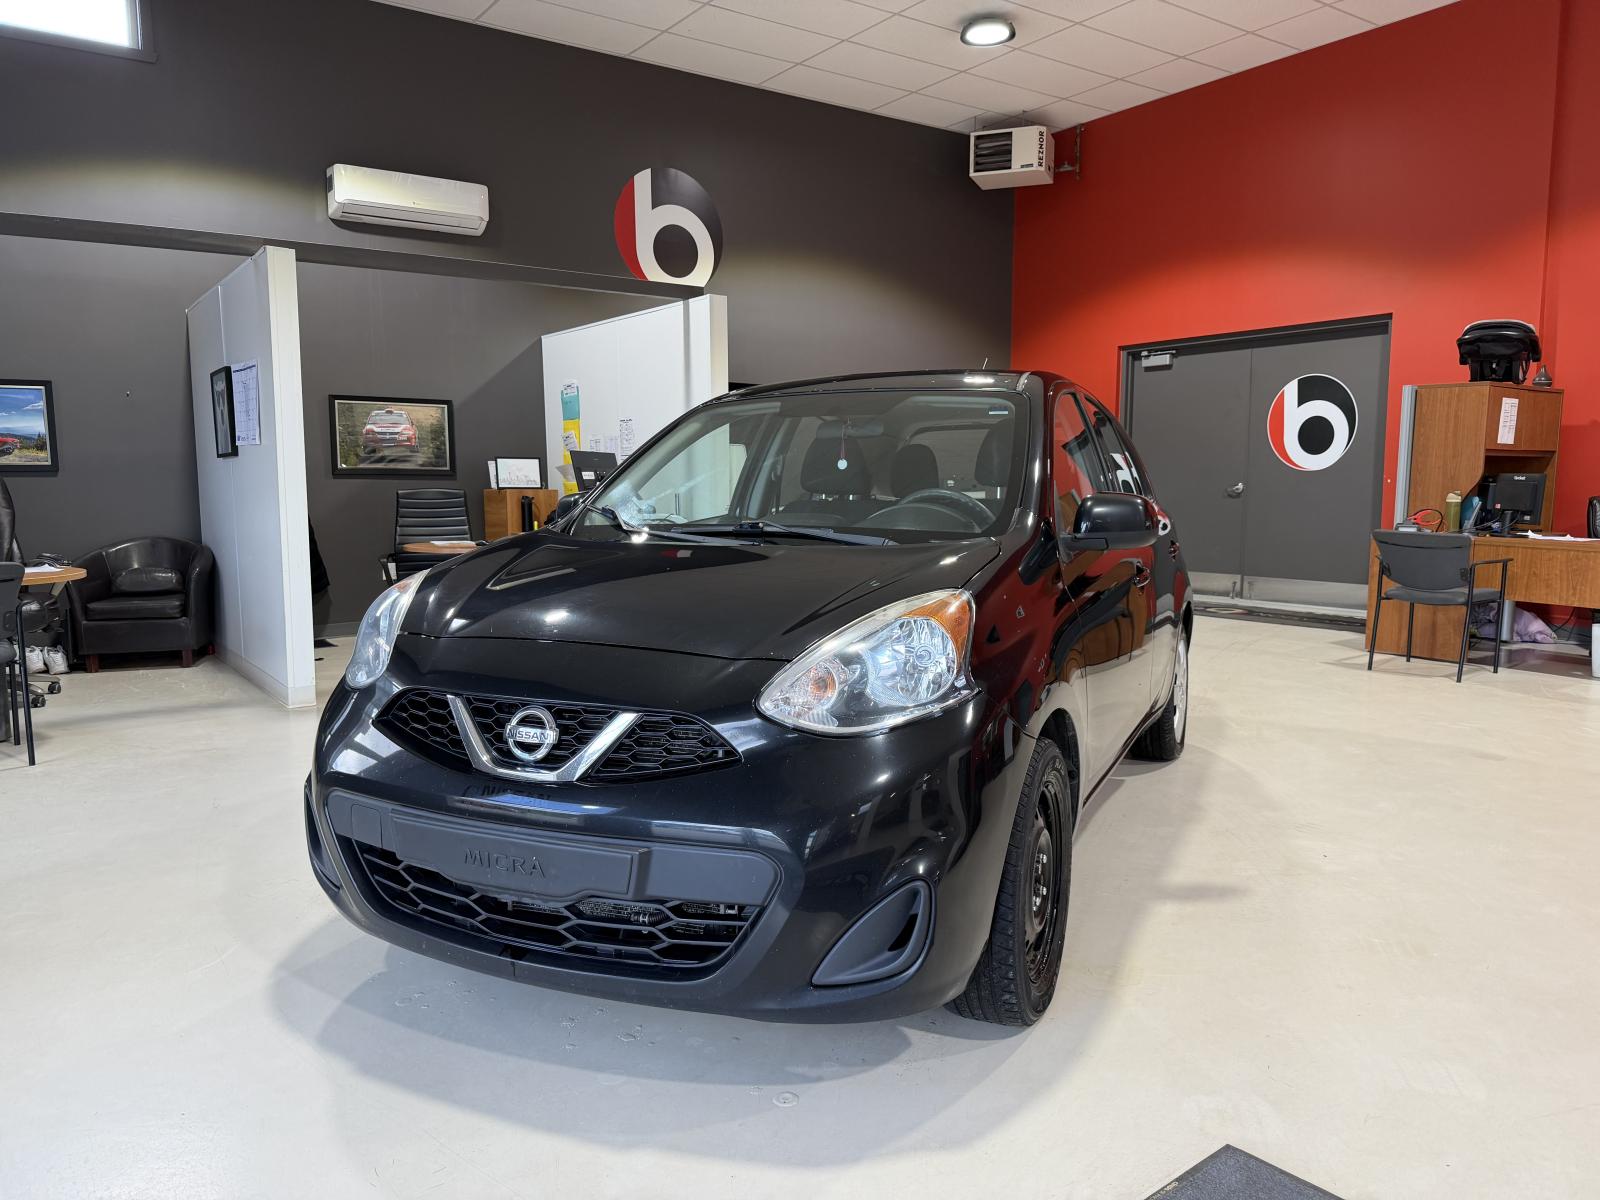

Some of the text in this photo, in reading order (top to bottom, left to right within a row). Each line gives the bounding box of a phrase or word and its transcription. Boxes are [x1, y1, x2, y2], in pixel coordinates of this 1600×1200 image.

[633, 167, 715, 288] b
[1283, 377, 1350, 471] b
[506, 728, 549, 741] NISSAN
[464, 847, 546, 878] MICRA
